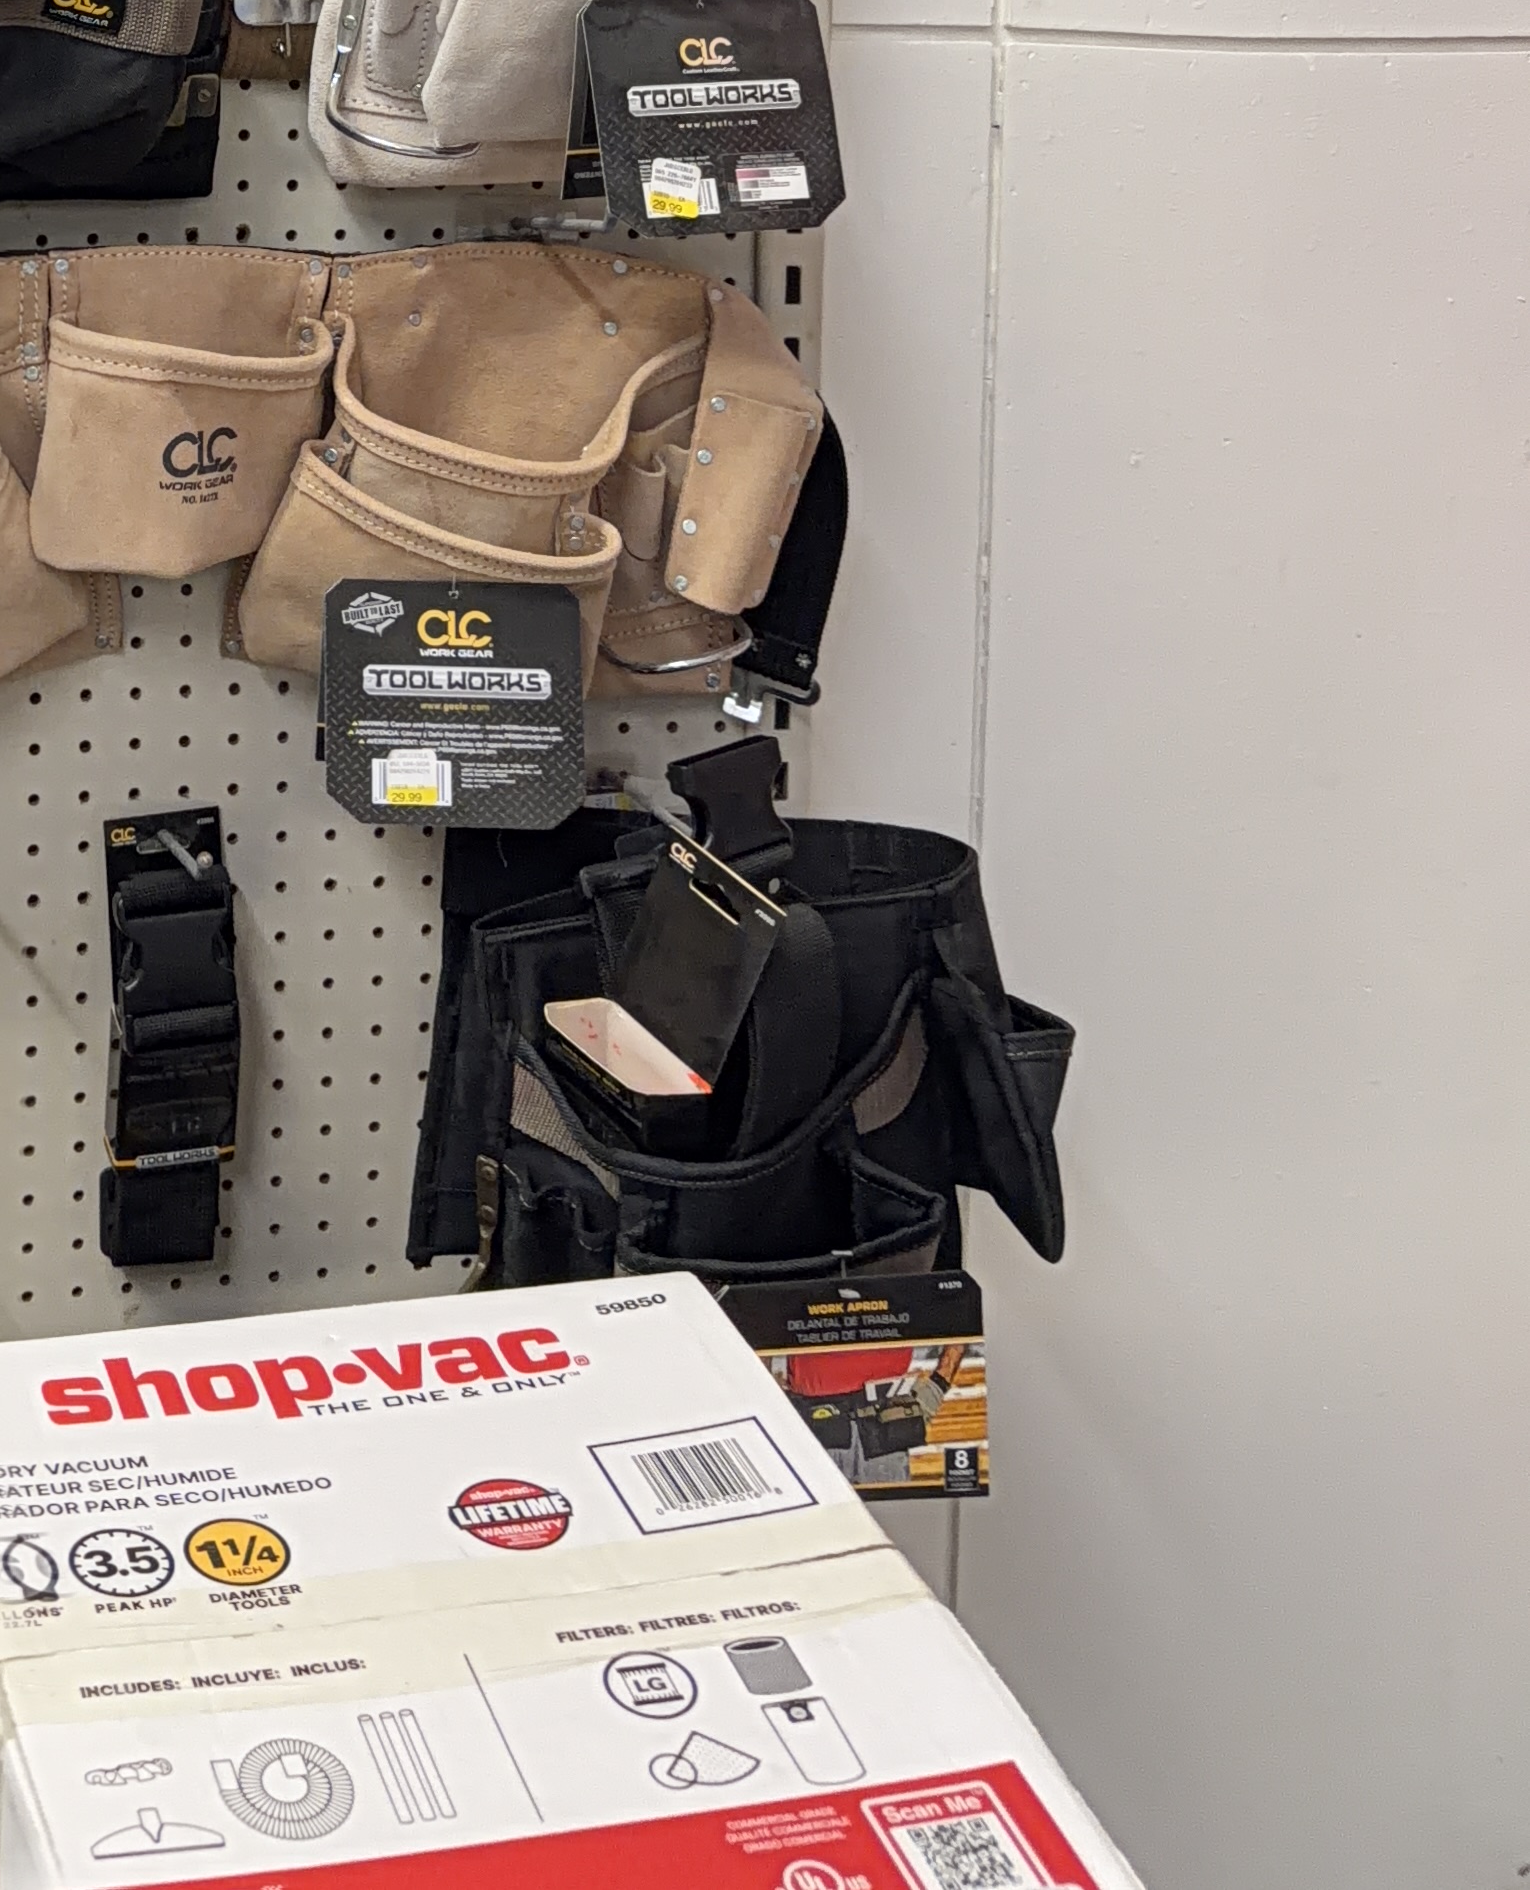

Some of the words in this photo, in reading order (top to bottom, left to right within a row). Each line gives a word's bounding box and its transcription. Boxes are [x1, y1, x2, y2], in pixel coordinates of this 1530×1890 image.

[679, 36, 734, 67] CLC
[652, 199, 682, 214] 29.99
[159, 481, 203, 491] WORK
[205, 474, 234, 489] GEAR
[344, 610, 369, 623] BUILT
[378, 603, 402, 617] LAST
[417, 609, 493, 648] CLC
[419, 648, 456, 658] WORK
[458, 649, 494, 658] GEAR
[392, 793, 422, 803] 29.99
[595, 1292, 666, 1316] 59850
[808, 1301, 845, 1315] WORK
[848, 1299, 889, 1313] APRON
[310, 1399, 369, 1416] THE
[382, 1389, 449, 1409] ONE
[460, 1386, 482, 1398] &
[493, 1372, 568, 1394] ONLY
[46, 1456, 148, 1476] VACUUM
[954, 1451, 970, 1468] 8
[86, 1495, 150, 1512] PARA
[155, 1476, 333, 1506] SECO/HUMEDO
[454, 1493, 572, 1524] LIFETIME
[478, 1517, 565, 1540] WARRANTY
[84, 1545, 161, 1579] 3.5
[209, 1584, 302, 1604] DIAMETER
[228, 1596, 292, 1612] TOOLS
[555, 1624, 634, 1644] FILTERS:
[639, 1612, 717, 1634] FILTRES:
[721, 1601, 802, 1623] FILTROS:
[79, 1678, 181, 1699] INCLUDES:
[191, 1667, 282, 1690] INCLUYE:
[290, 1658, 367, 1676] INCLUS:
[633, 1675, 667, 1693] LG
[882, 1801, 942, 1824] Scan
[947, 1793, 984, 1814] Me
